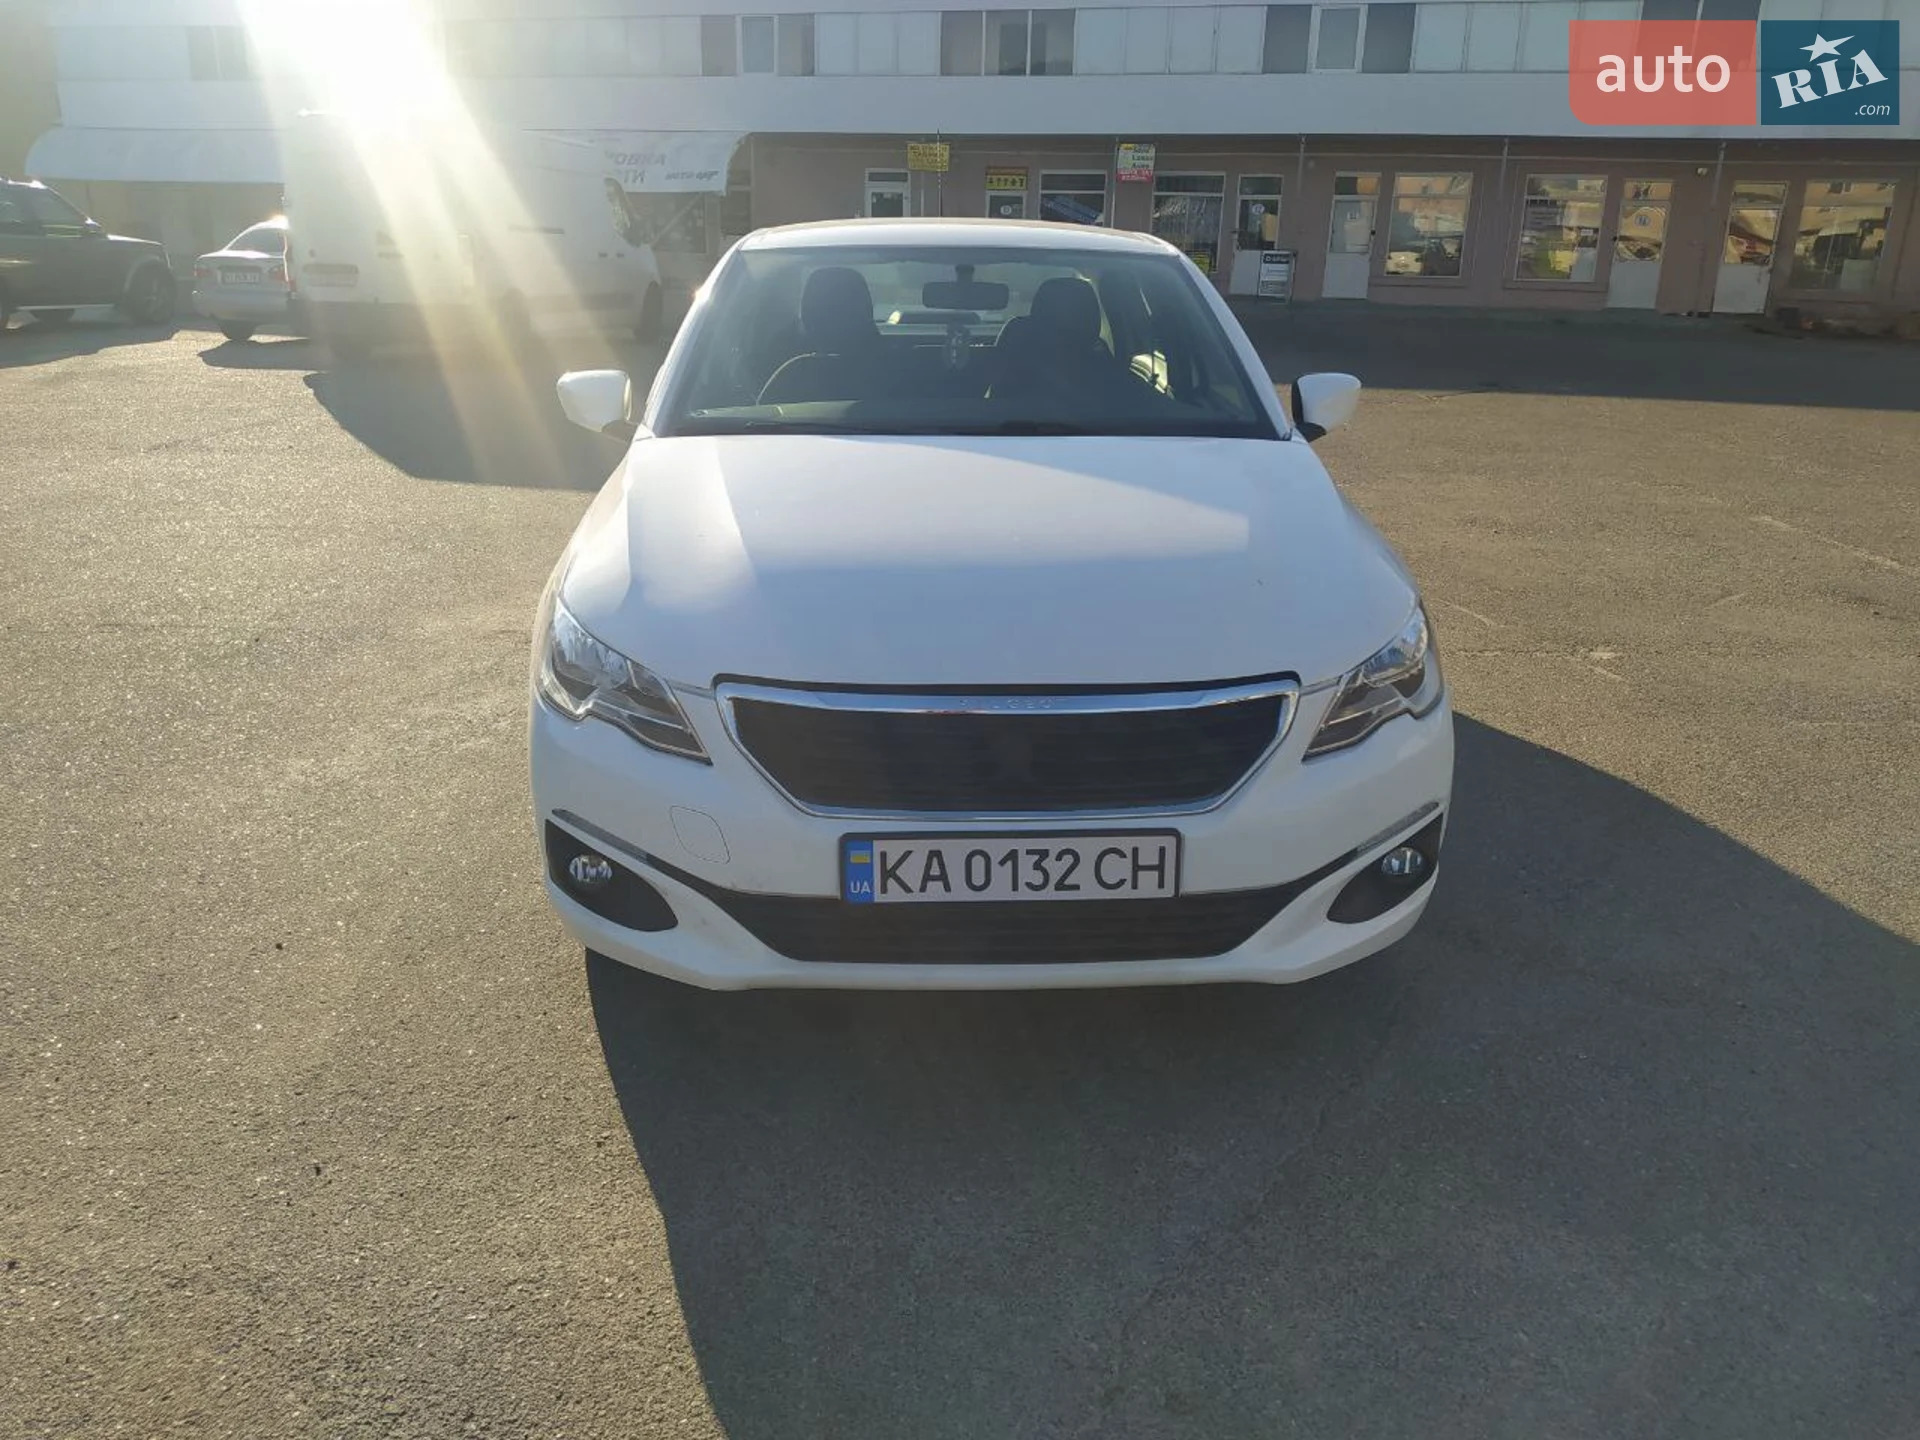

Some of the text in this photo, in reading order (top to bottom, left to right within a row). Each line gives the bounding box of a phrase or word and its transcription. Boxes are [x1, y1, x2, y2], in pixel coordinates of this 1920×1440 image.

[880, 845, 1167, 895] KA 0132 CH
[851, 881, 872, 895] UA
